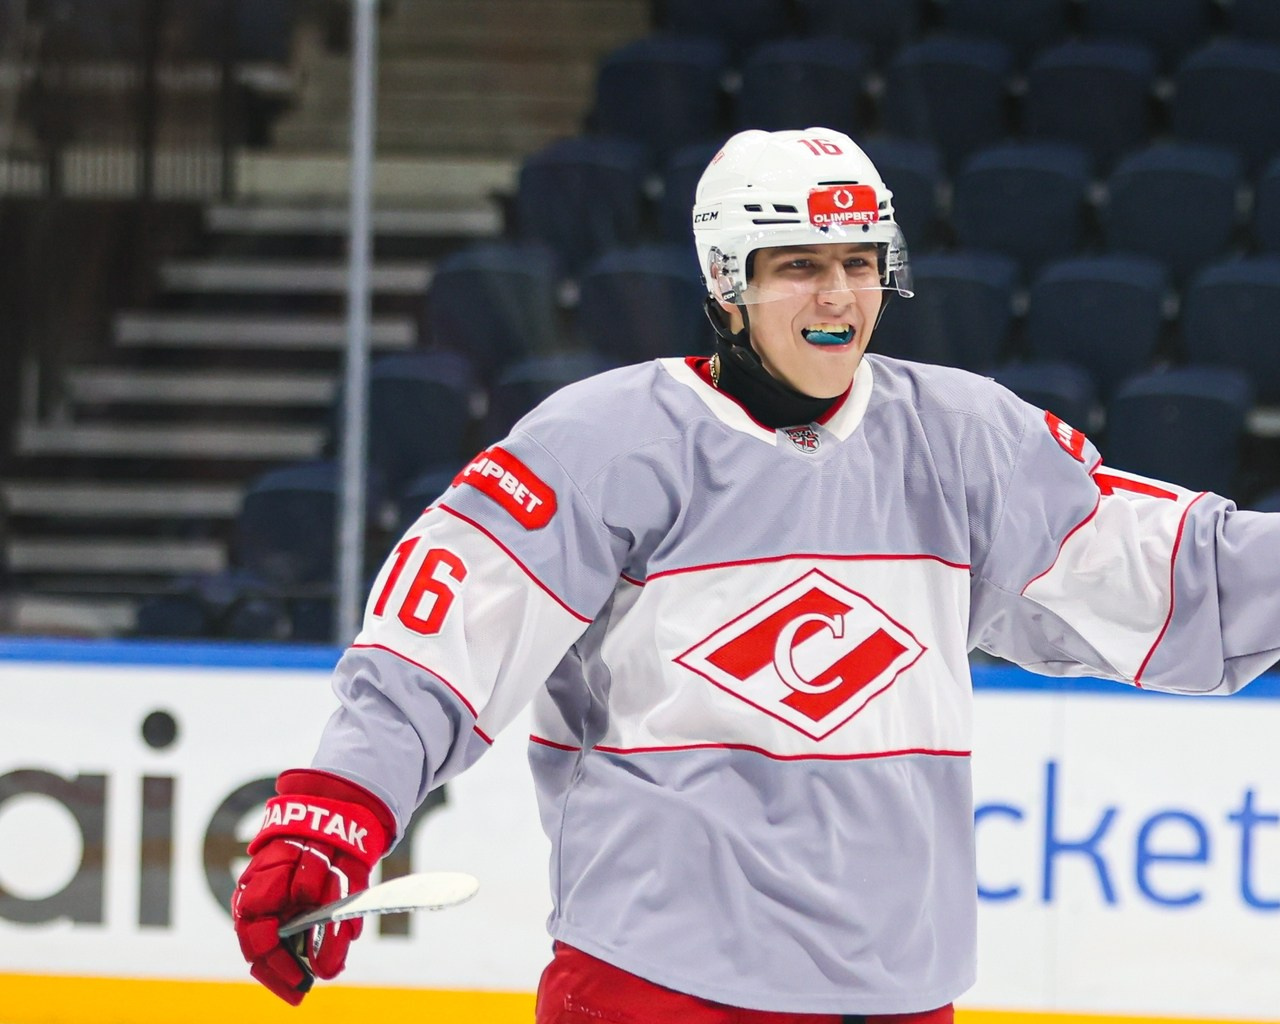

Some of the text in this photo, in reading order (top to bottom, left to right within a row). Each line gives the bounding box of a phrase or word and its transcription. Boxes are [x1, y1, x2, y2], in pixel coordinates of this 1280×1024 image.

[797, 138, 844, 157] 16
[694, 210, 720, 224] CCM
[813, 210, 876, 224] OLIMPBET
[372, 535, 468, 636] 16
